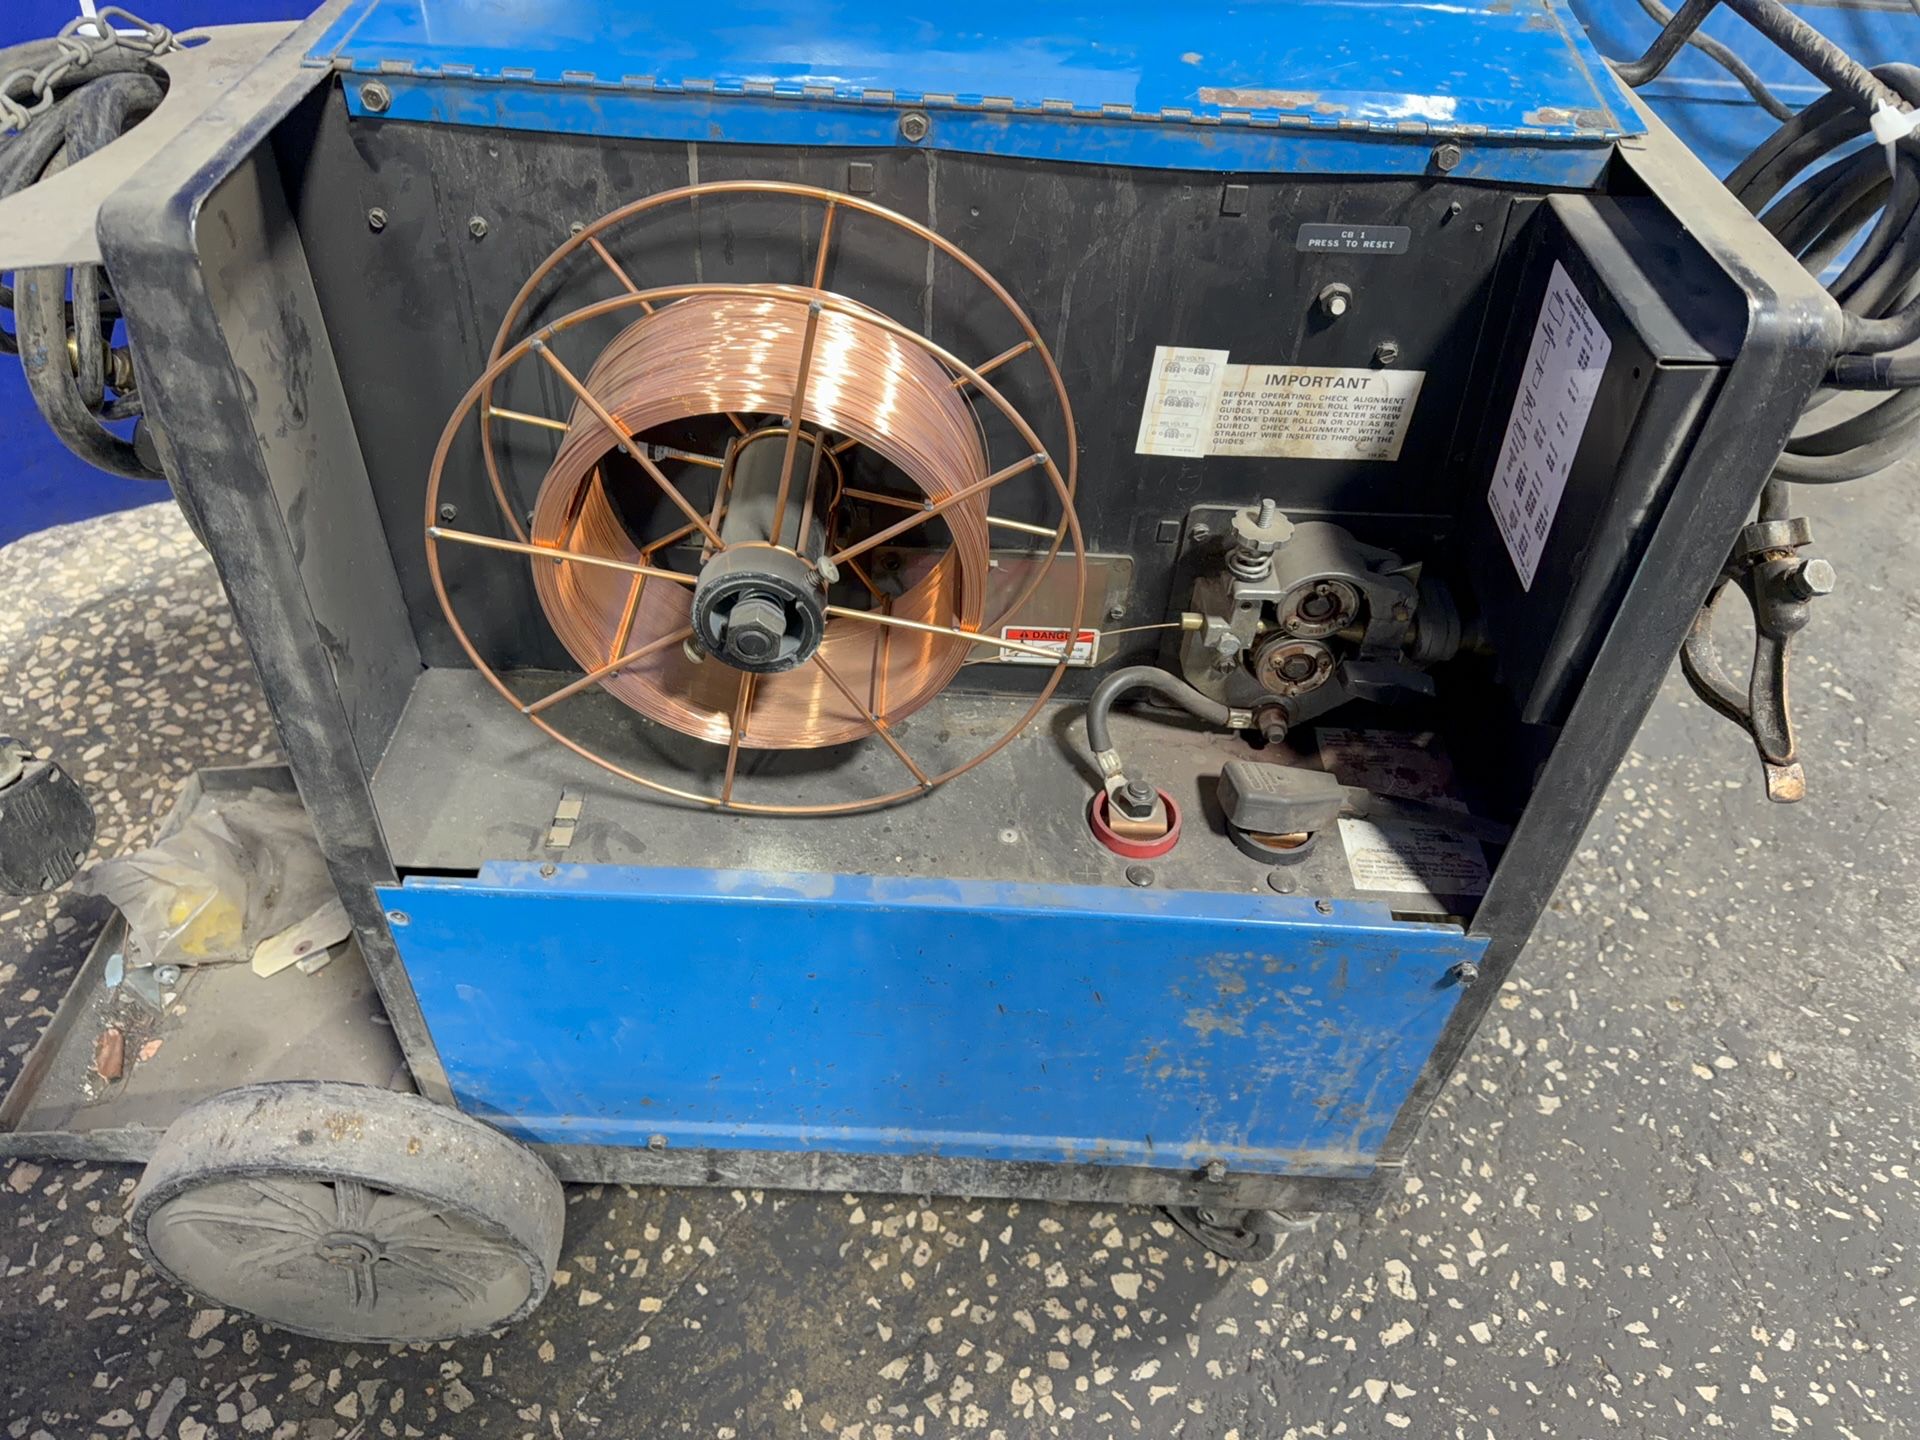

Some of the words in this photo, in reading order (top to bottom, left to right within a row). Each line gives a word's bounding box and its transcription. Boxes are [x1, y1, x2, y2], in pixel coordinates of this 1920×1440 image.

[1360, 231, 1365, 239] 1
[1308, 239, 1339, 247] PRESS
[1363, 241, 1394, 249] RESET
[1265, 374, 1371, 389] IMPORTANT
[1353, 396, 1406, 405] ALIGNMENT
[1306, 410, 1329, 418] TURN
[1332, 411, 1366, 419] CENTER
[1285, 433, 1328, 441] INSERTED
[1331, 434, 1373, 442] THROUGH
[1032, 631, 1079, 640] DANGE
